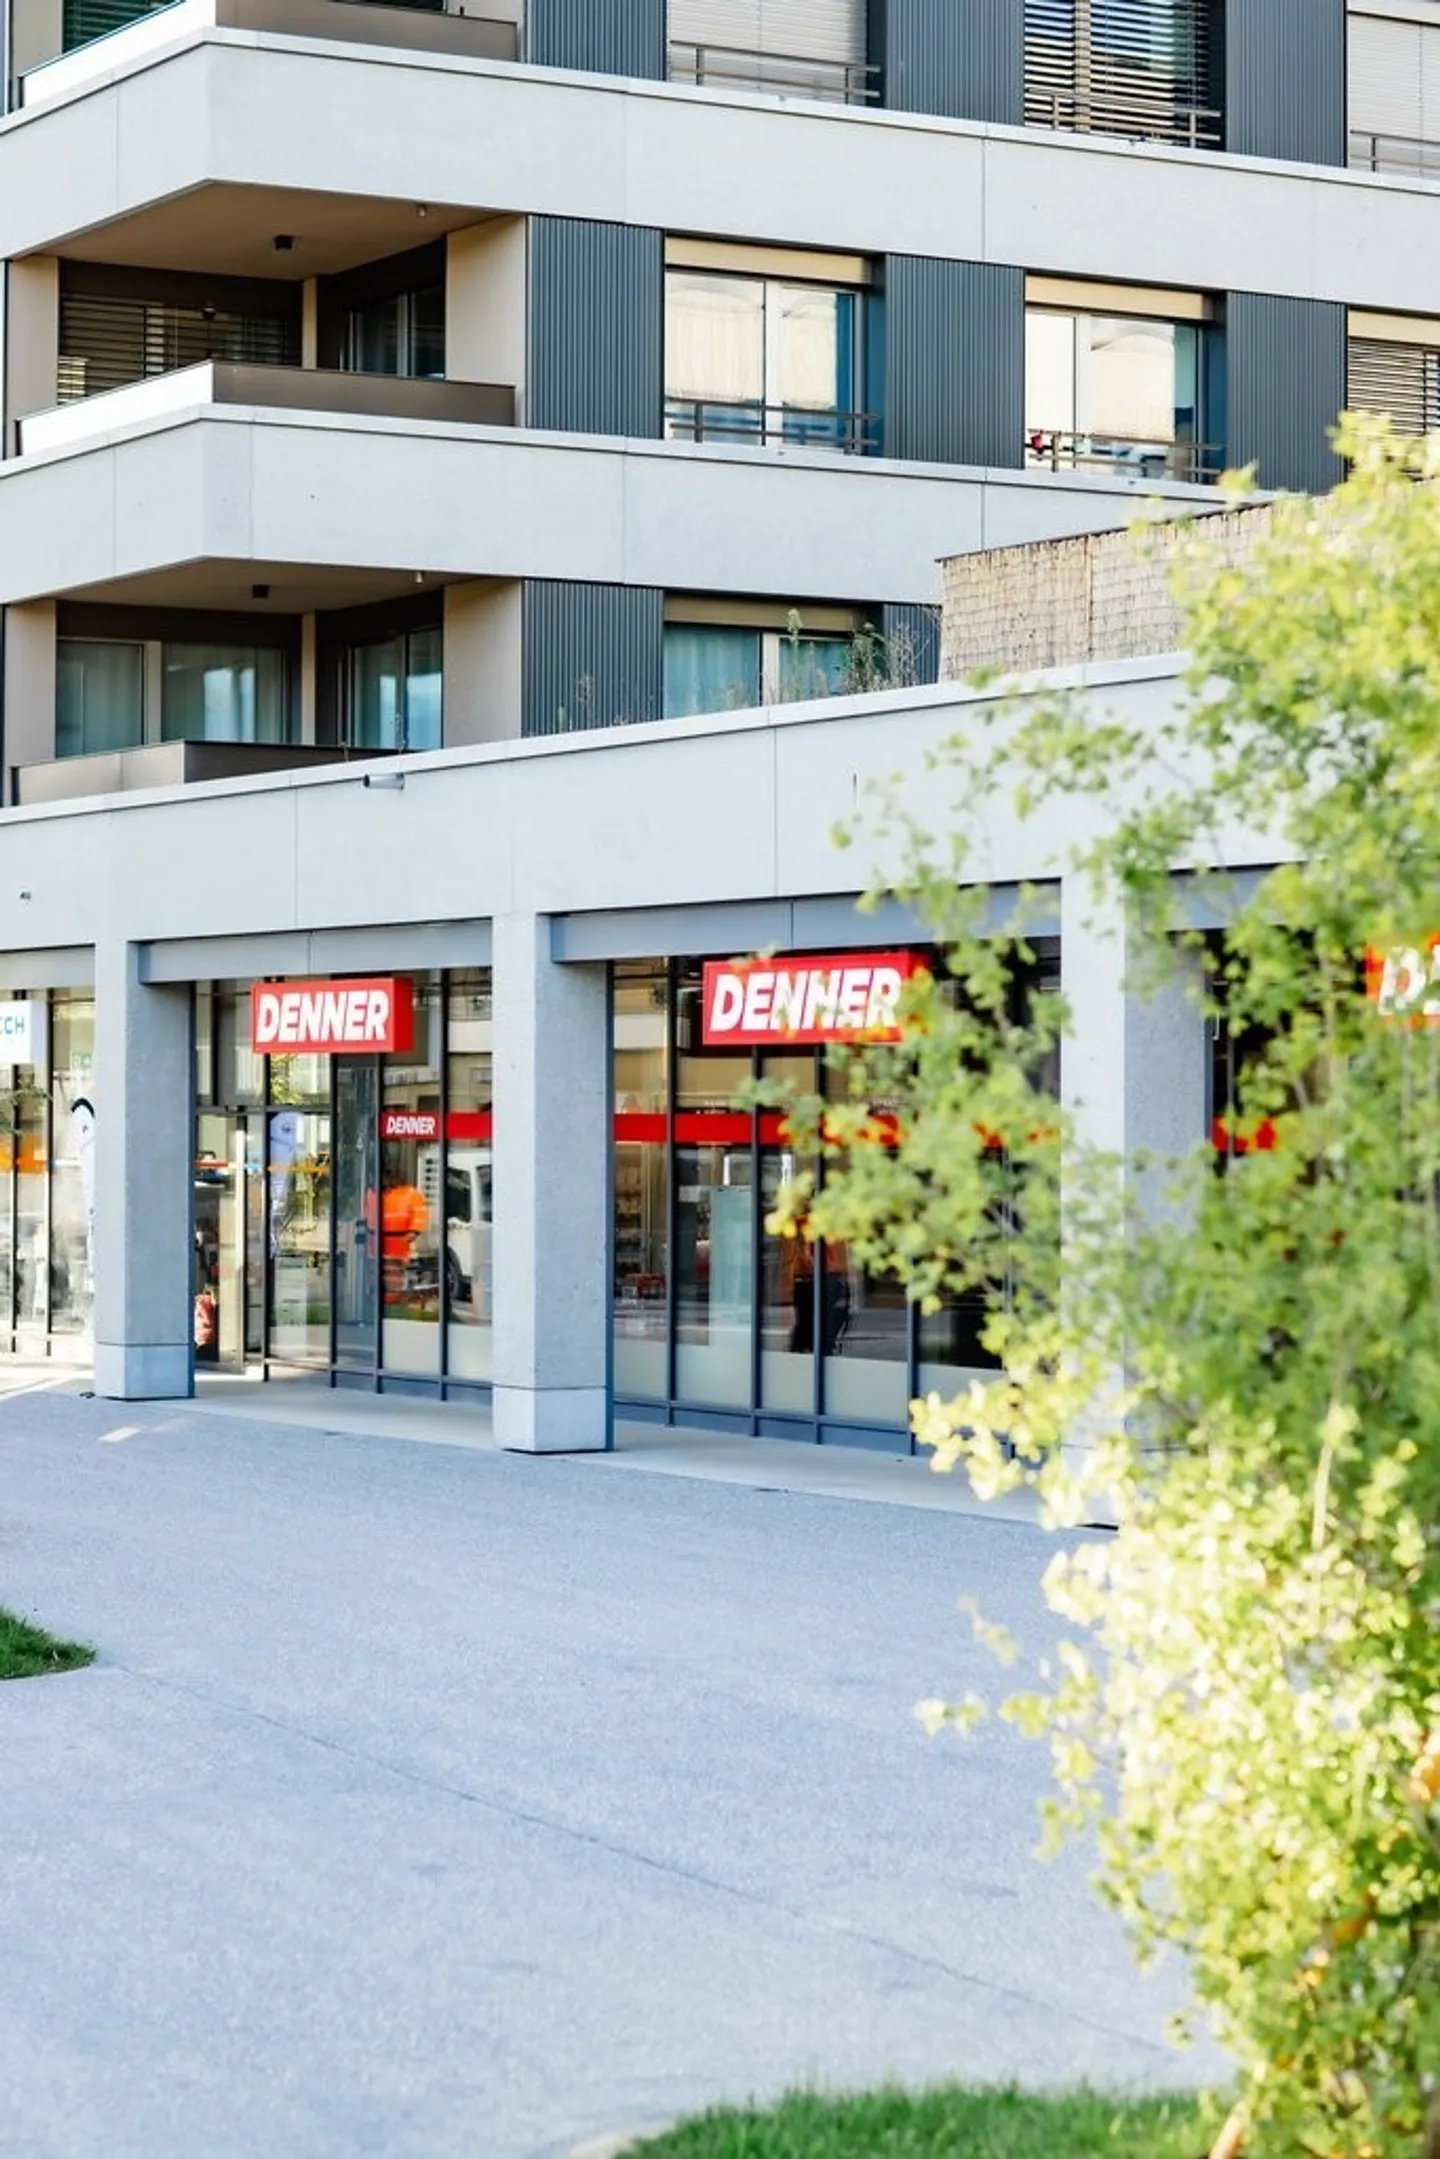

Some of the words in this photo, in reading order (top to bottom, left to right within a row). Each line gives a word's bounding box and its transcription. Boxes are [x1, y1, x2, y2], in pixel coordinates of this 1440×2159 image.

[256, 989, 389, 1043] DENNER
[709, 967, 901, 1032] DENNER
[0, 1016, 25, 1035] CH
[386, 1115, 436, 1135] DENNER
